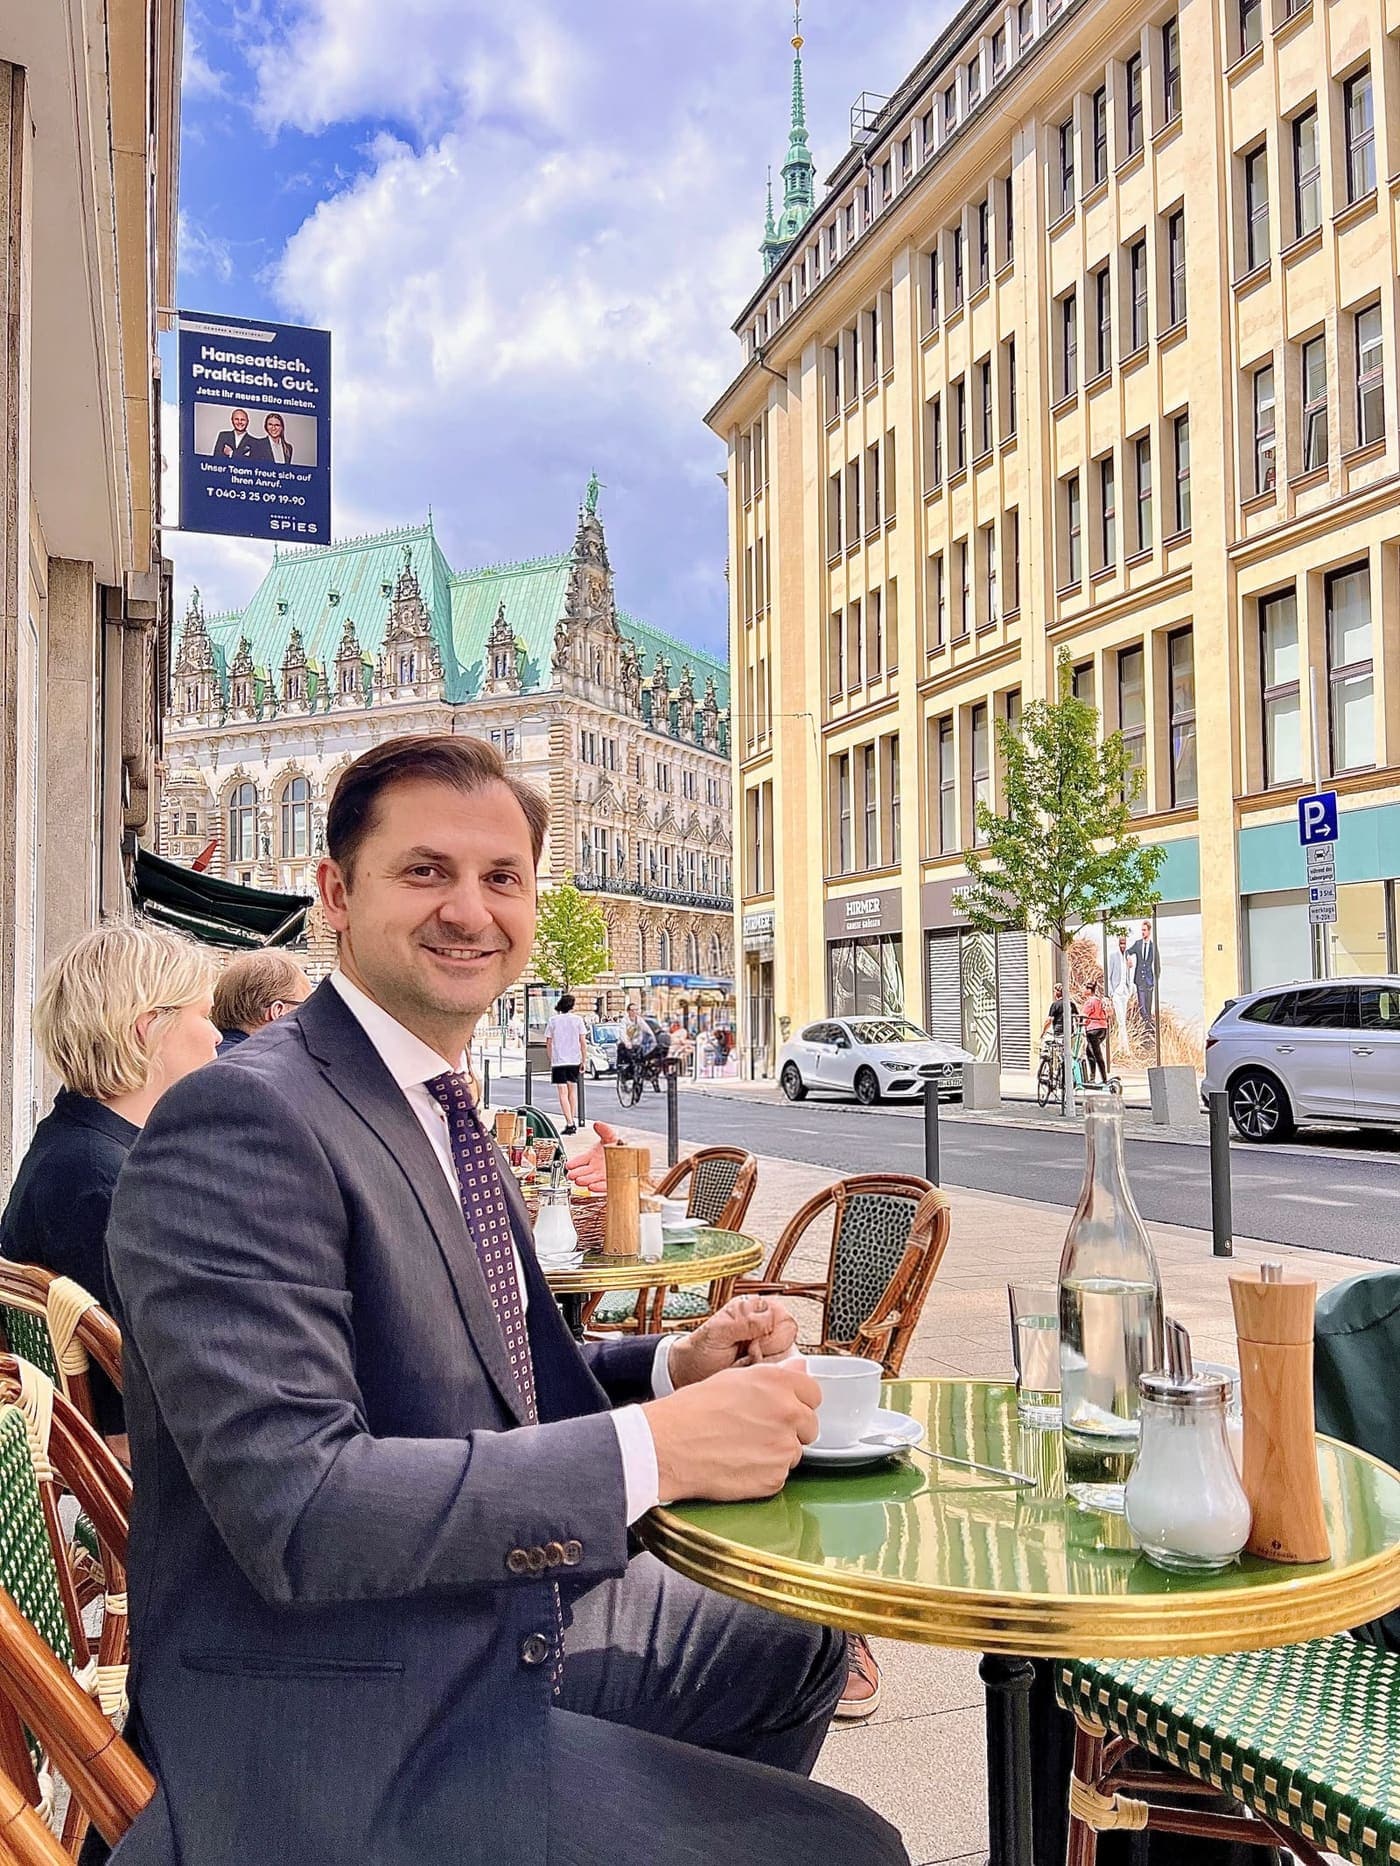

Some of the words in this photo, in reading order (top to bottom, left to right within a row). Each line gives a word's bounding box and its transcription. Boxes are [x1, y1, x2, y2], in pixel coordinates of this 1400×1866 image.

[201, 346, 311, 374] Hanseatisch.
[192, 363, 279, 388] Praktisch.
[282, 376, 319, 393] Gut.
[196, 387, 221, 398] Jetzt
[222, 390, 234, 399] Ihr
[235, 392, 261, 402] neues
[262, 394, 283, 405] Büro
[284, 398, 316, 409] mieten.
[200, 463, 227, 474] Unser
[228, 465, 253, 476] Team
[254, 468, 277, 478] freut
[278, 471, 295, 481] sich
[296, 473, 312, 483] auf
[231, 475, 254, 486] Ihren
[255, 478, 282, 489] Anruf.
[206, 488, 216, 497] T
[216, 489, 247, 501] 040-3
[248, 492, 261, 502] 25
[263, 493, 277, 503] 09
[279, 494, 306, 506] 19-90
[270, 520, 318, 534] SPIES
[1304, 801, 1326, 839] P
[846, 898, 880, 916] HIRMER
